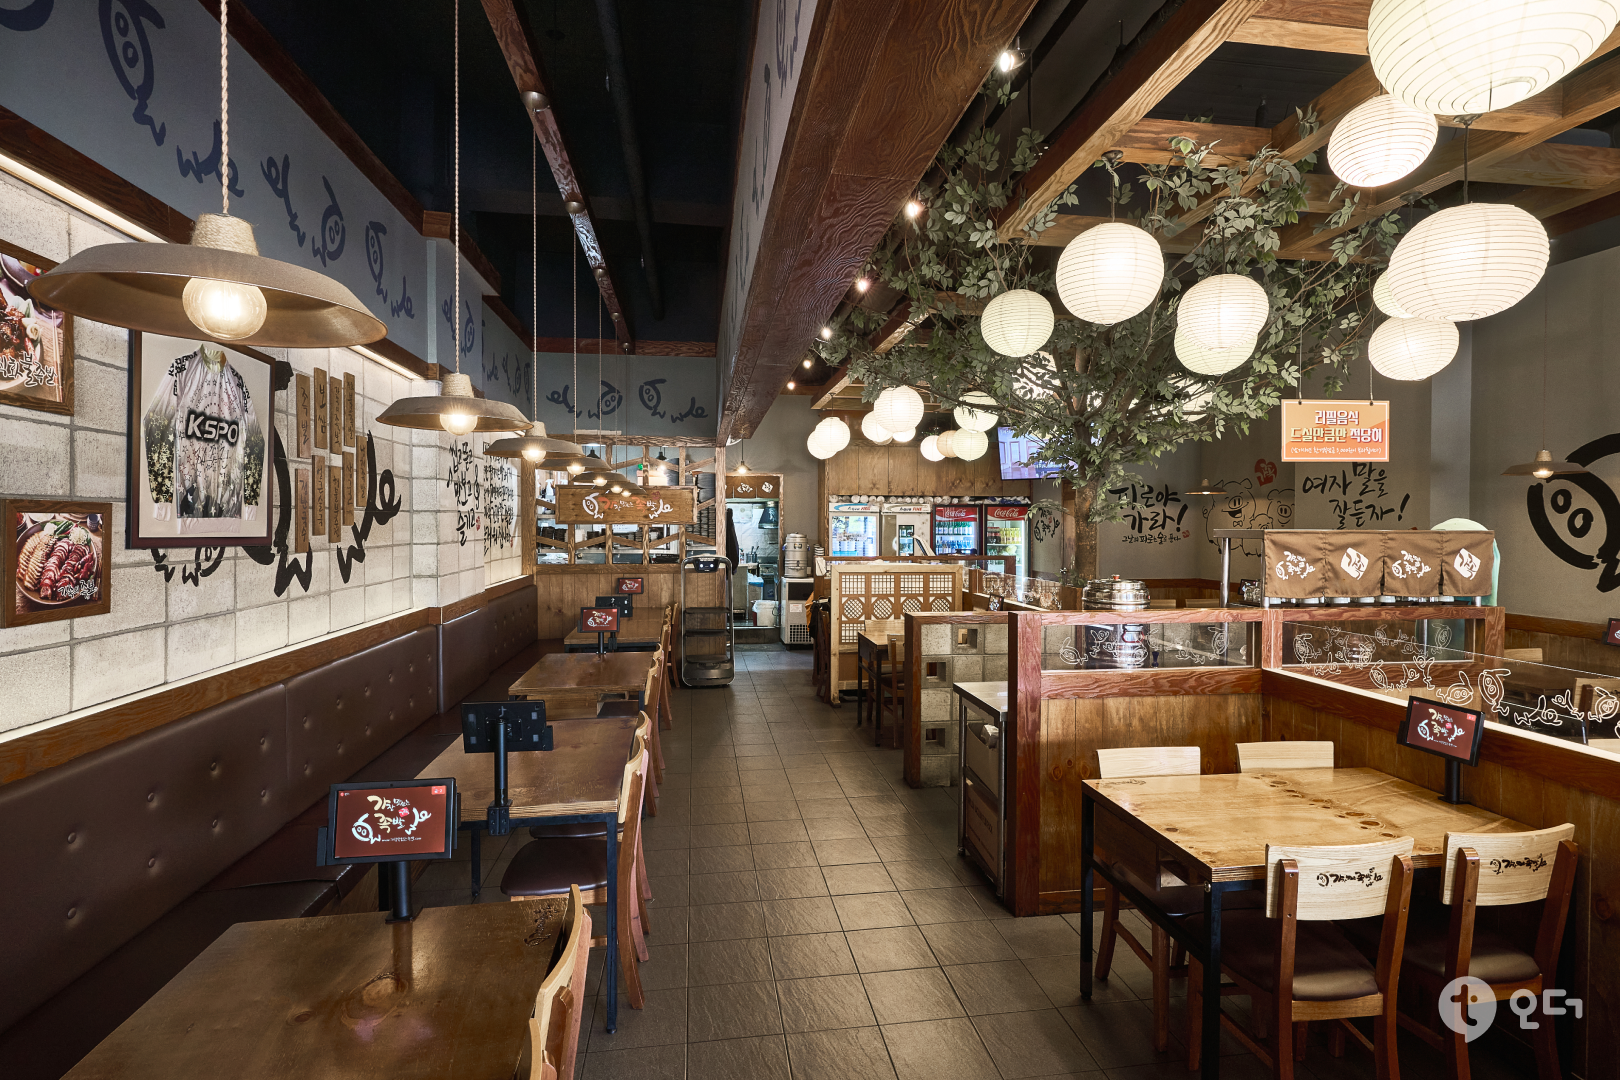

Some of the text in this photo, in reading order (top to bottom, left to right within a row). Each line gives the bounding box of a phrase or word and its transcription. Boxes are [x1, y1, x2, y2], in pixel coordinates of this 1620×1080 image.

[187, 414, 239, 443] KSPO
[1315, 410, 1359, 425] 리필음식
[1290, 427, 1383, 443] 드실만큼만 적당히
[1302, 462, 1389, 498] 여자 말을
[1108, 483, 1181, 510] 피로야
[1123, 503, 1189, 534] 가라!
